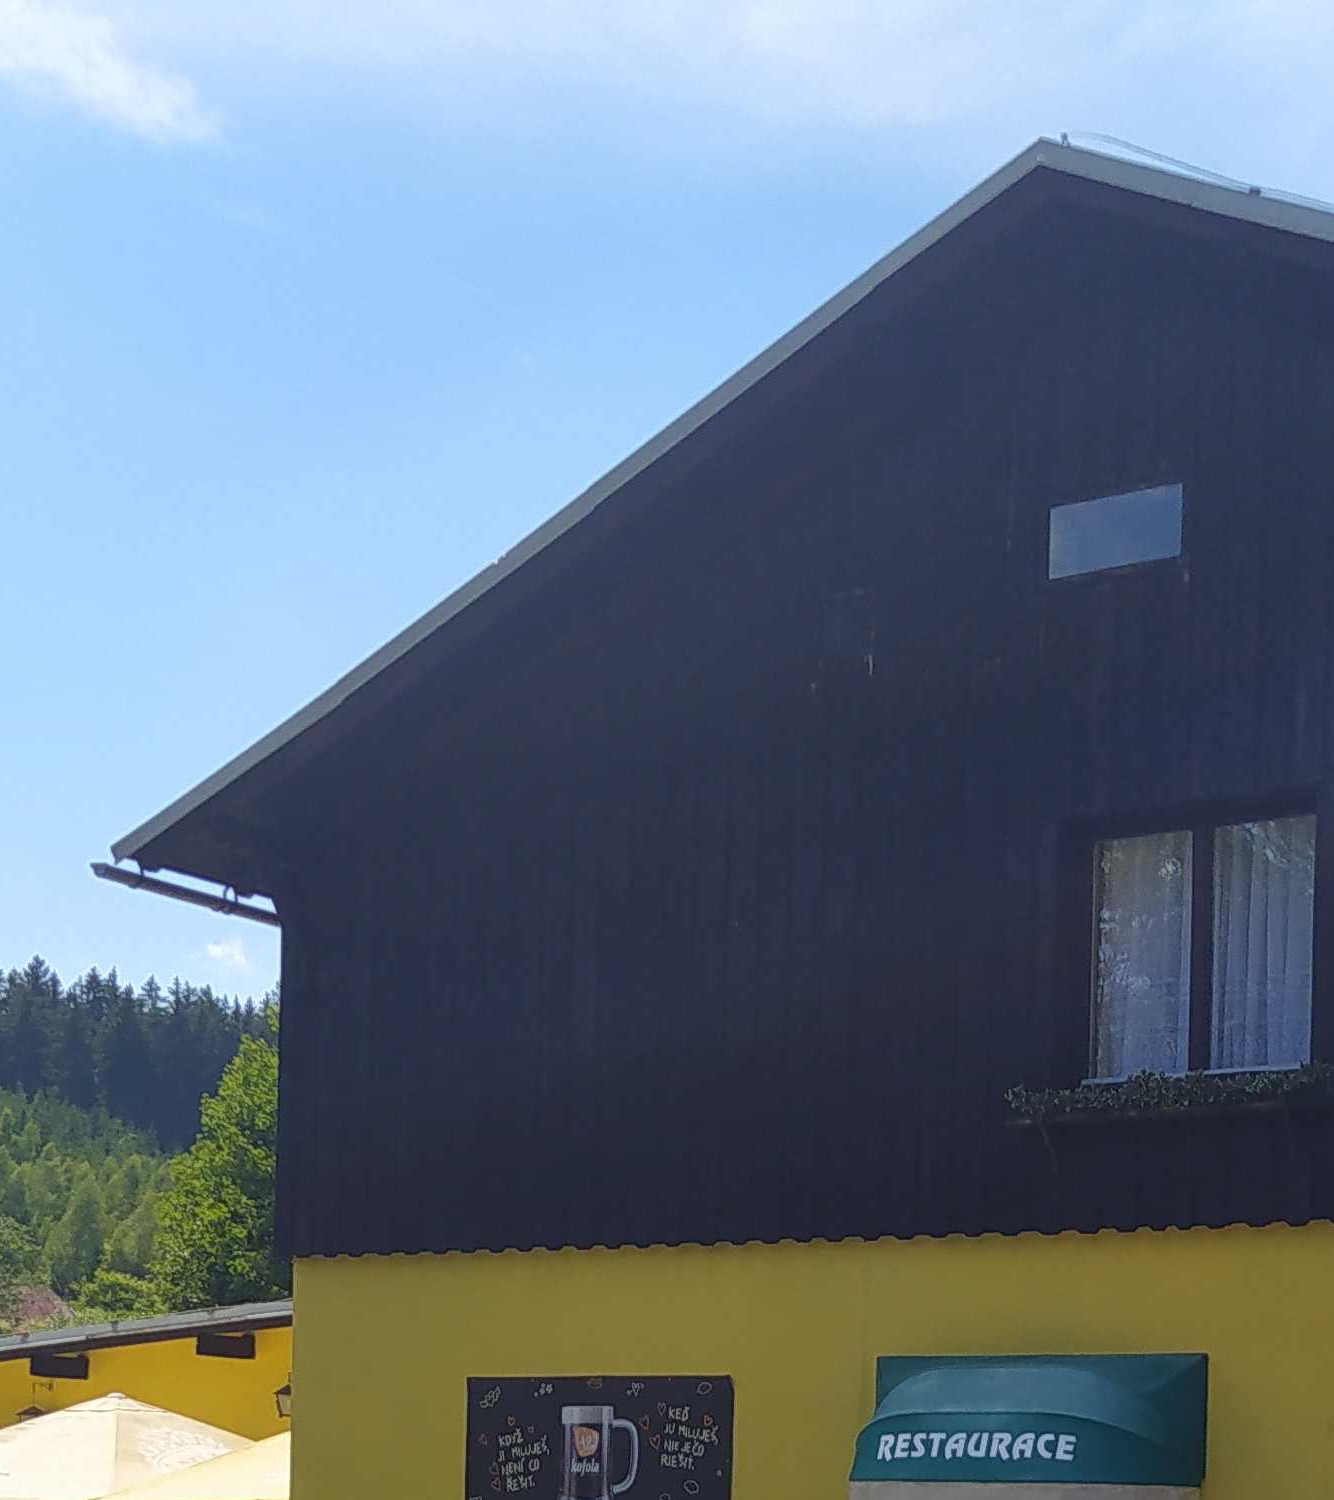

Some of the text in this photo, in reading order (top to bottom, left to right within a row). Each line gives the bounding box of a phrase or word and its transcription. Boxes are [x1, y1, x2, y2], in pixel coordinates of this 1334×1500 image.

[663, 1422, 676, 1435] JU
[497, 1450, 506, 1462] JI
[663, 1438, 705, 1457] NIE JE ČO
[876, 1431, 1077, 1462] RESTAURACE
[501, 1456, 540, 1476] NENÍ CO
[570, 1457, 600, 1477] kofola
